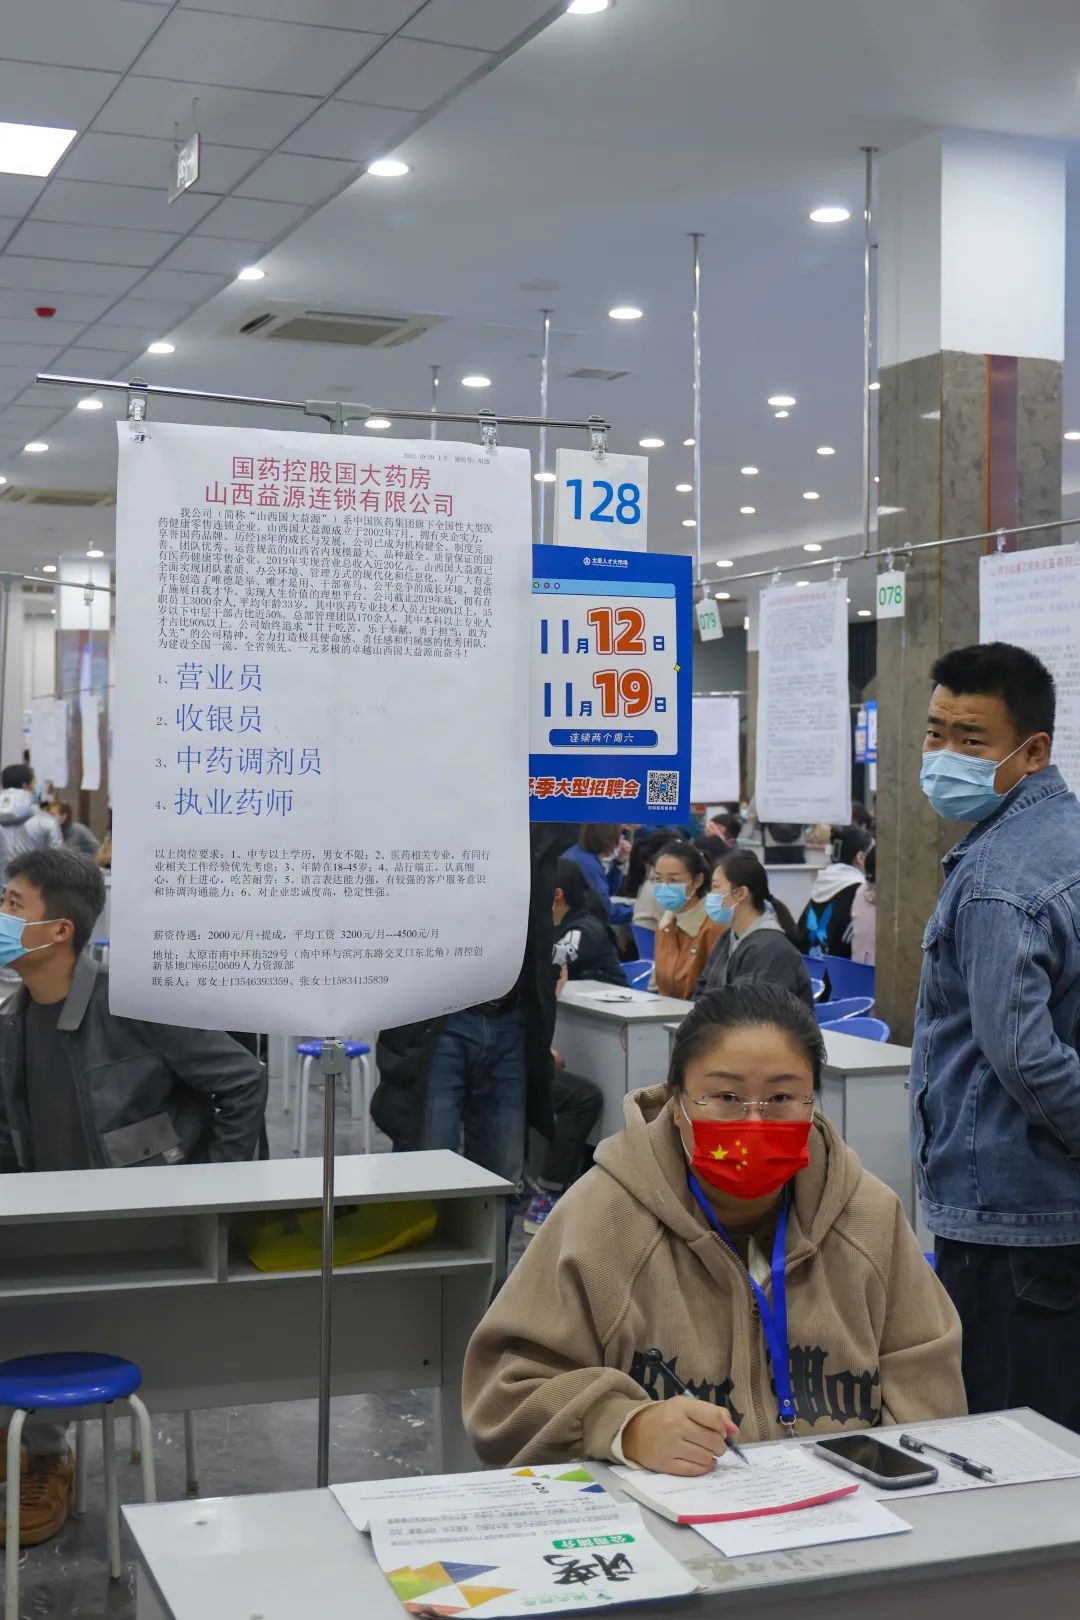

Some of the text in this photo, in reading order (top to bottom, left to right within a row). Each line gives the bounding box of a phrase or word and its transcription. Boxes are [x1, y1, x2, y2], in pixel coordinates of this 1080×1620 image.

[232, 456, 431, 490] 国药控股国大药房
[205, 480, 453, 517] 山西益源连锁有限公司
[566, 479, 641, 525] 128
[879, 585, 902, 606] 078
[699, 612, 717, 630] 079
[569, 732, 635, 744] 连续两个周六
[560, 1535, 626, 1549] 公司简介
